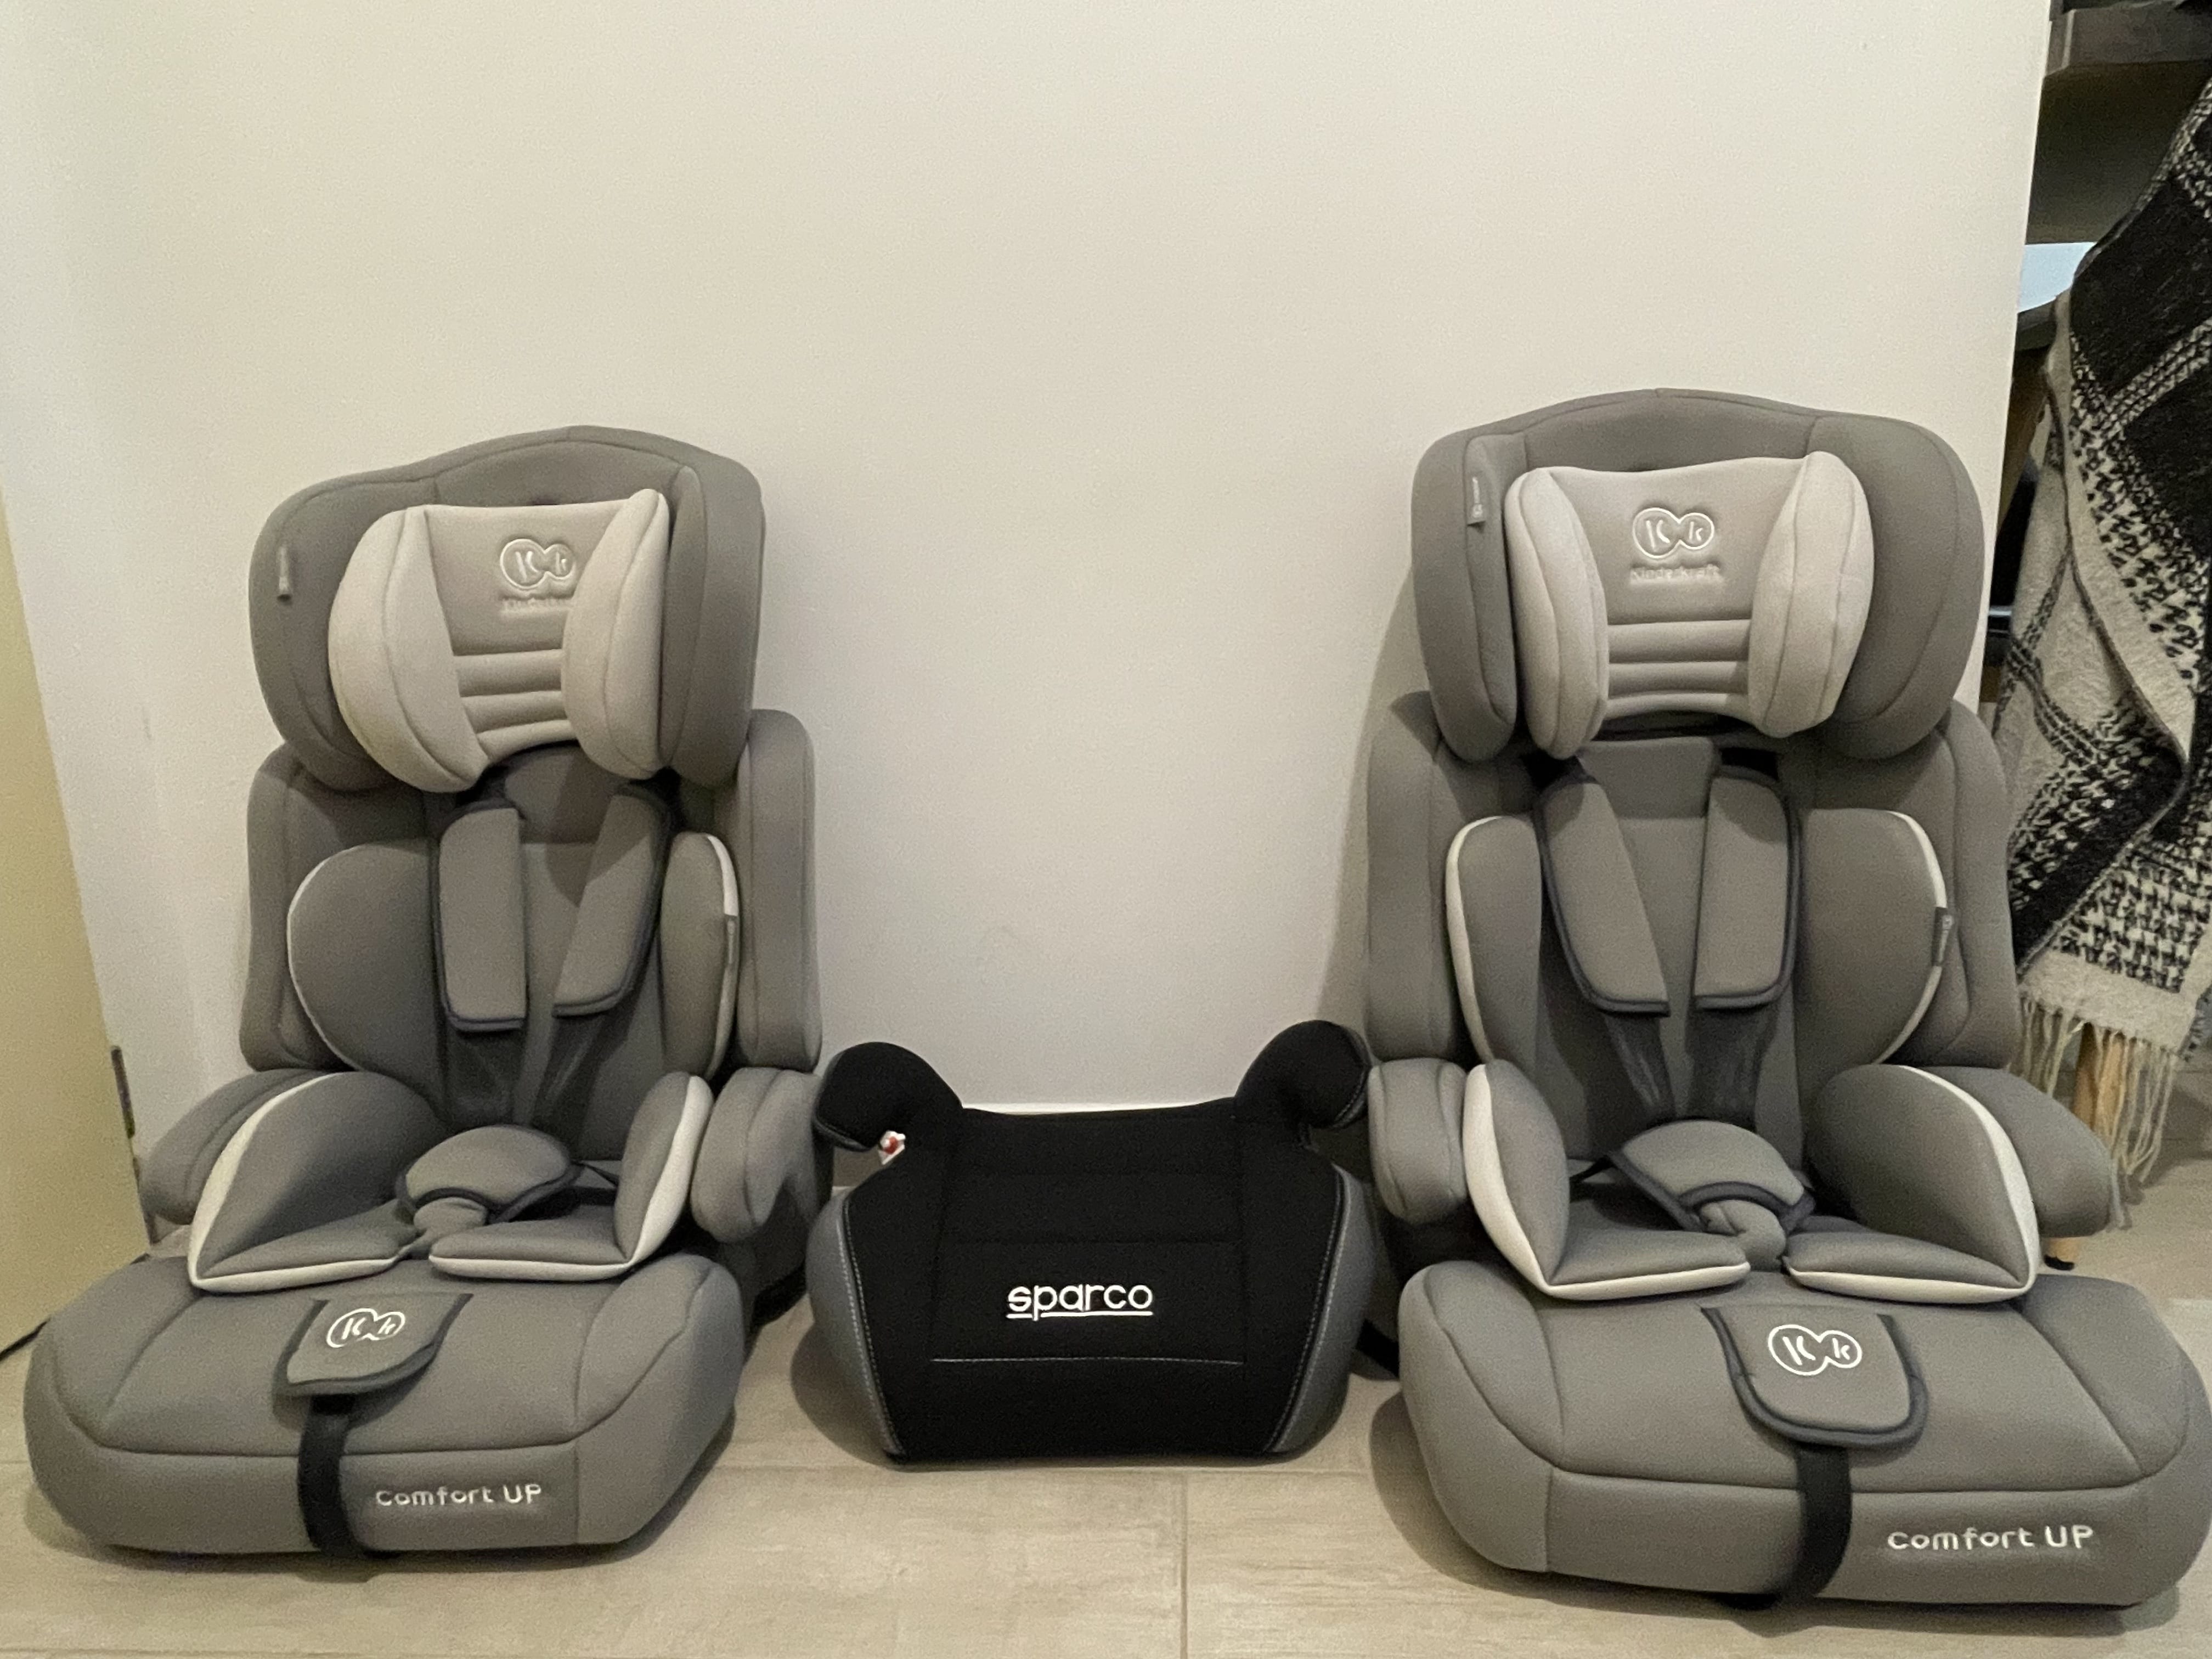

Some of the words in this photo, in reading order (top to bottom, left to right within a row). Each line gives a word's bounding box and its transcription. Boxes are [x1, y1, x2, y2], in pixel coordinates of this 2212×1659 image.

[1007, 1283, 1153, 1321] sparco
[503, 1483, 541, 1504] UP
[2044, 1524, 2094, 1549] UP
